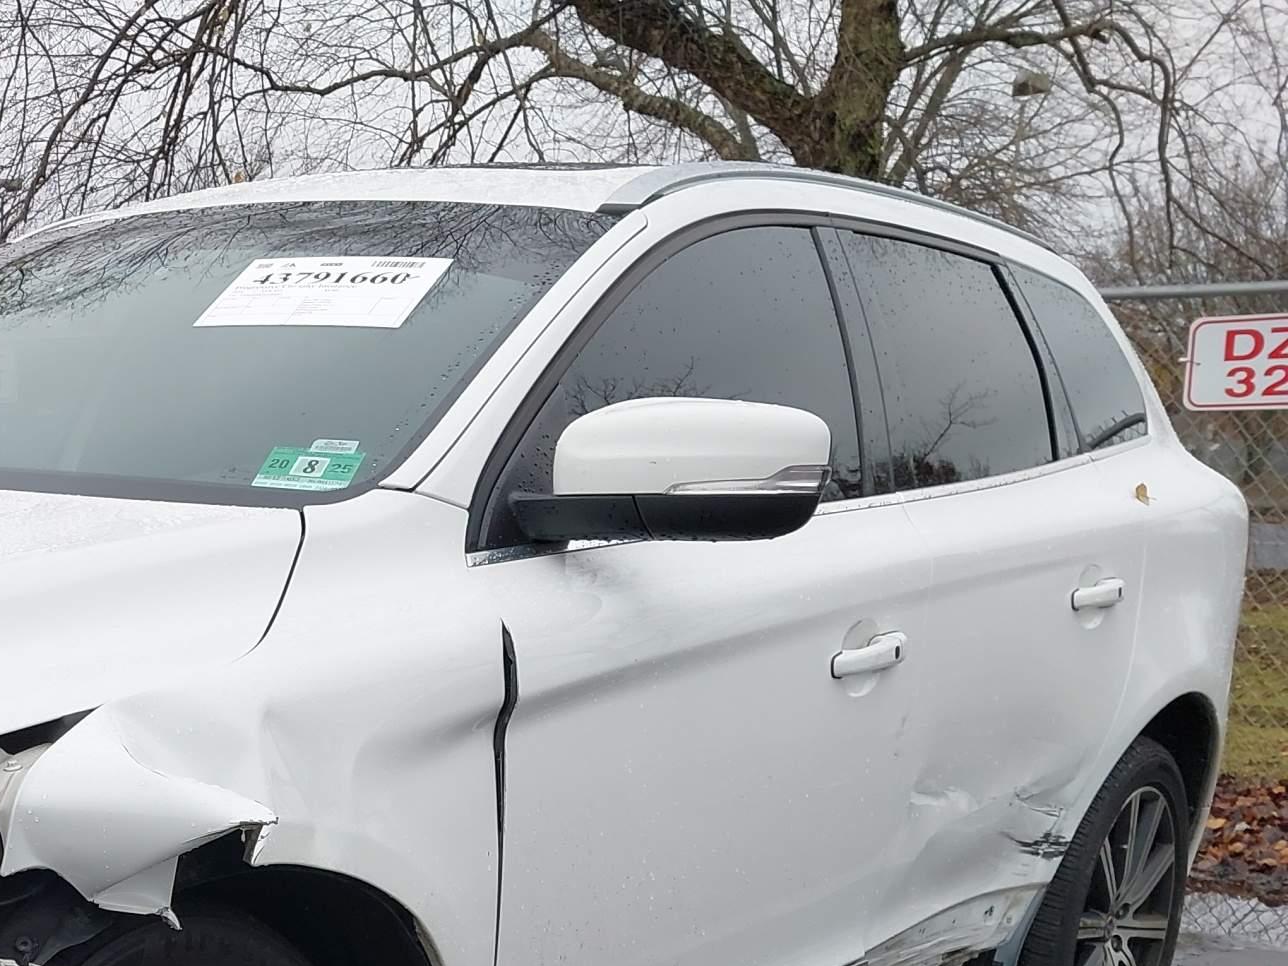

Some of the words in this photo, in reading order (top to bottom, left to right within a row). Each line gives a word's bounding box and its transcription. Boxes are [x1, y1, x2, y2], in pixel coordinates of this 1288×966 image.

[252, 271, 411, 285] 43791660
[1224, 327, 1288, 362] DZ
[1224, 364, 1288, 398] 32
[268, 458, 290, 470] 20
[302, 459, 319, 474] 8
[327, 463, 354, 474] 25
